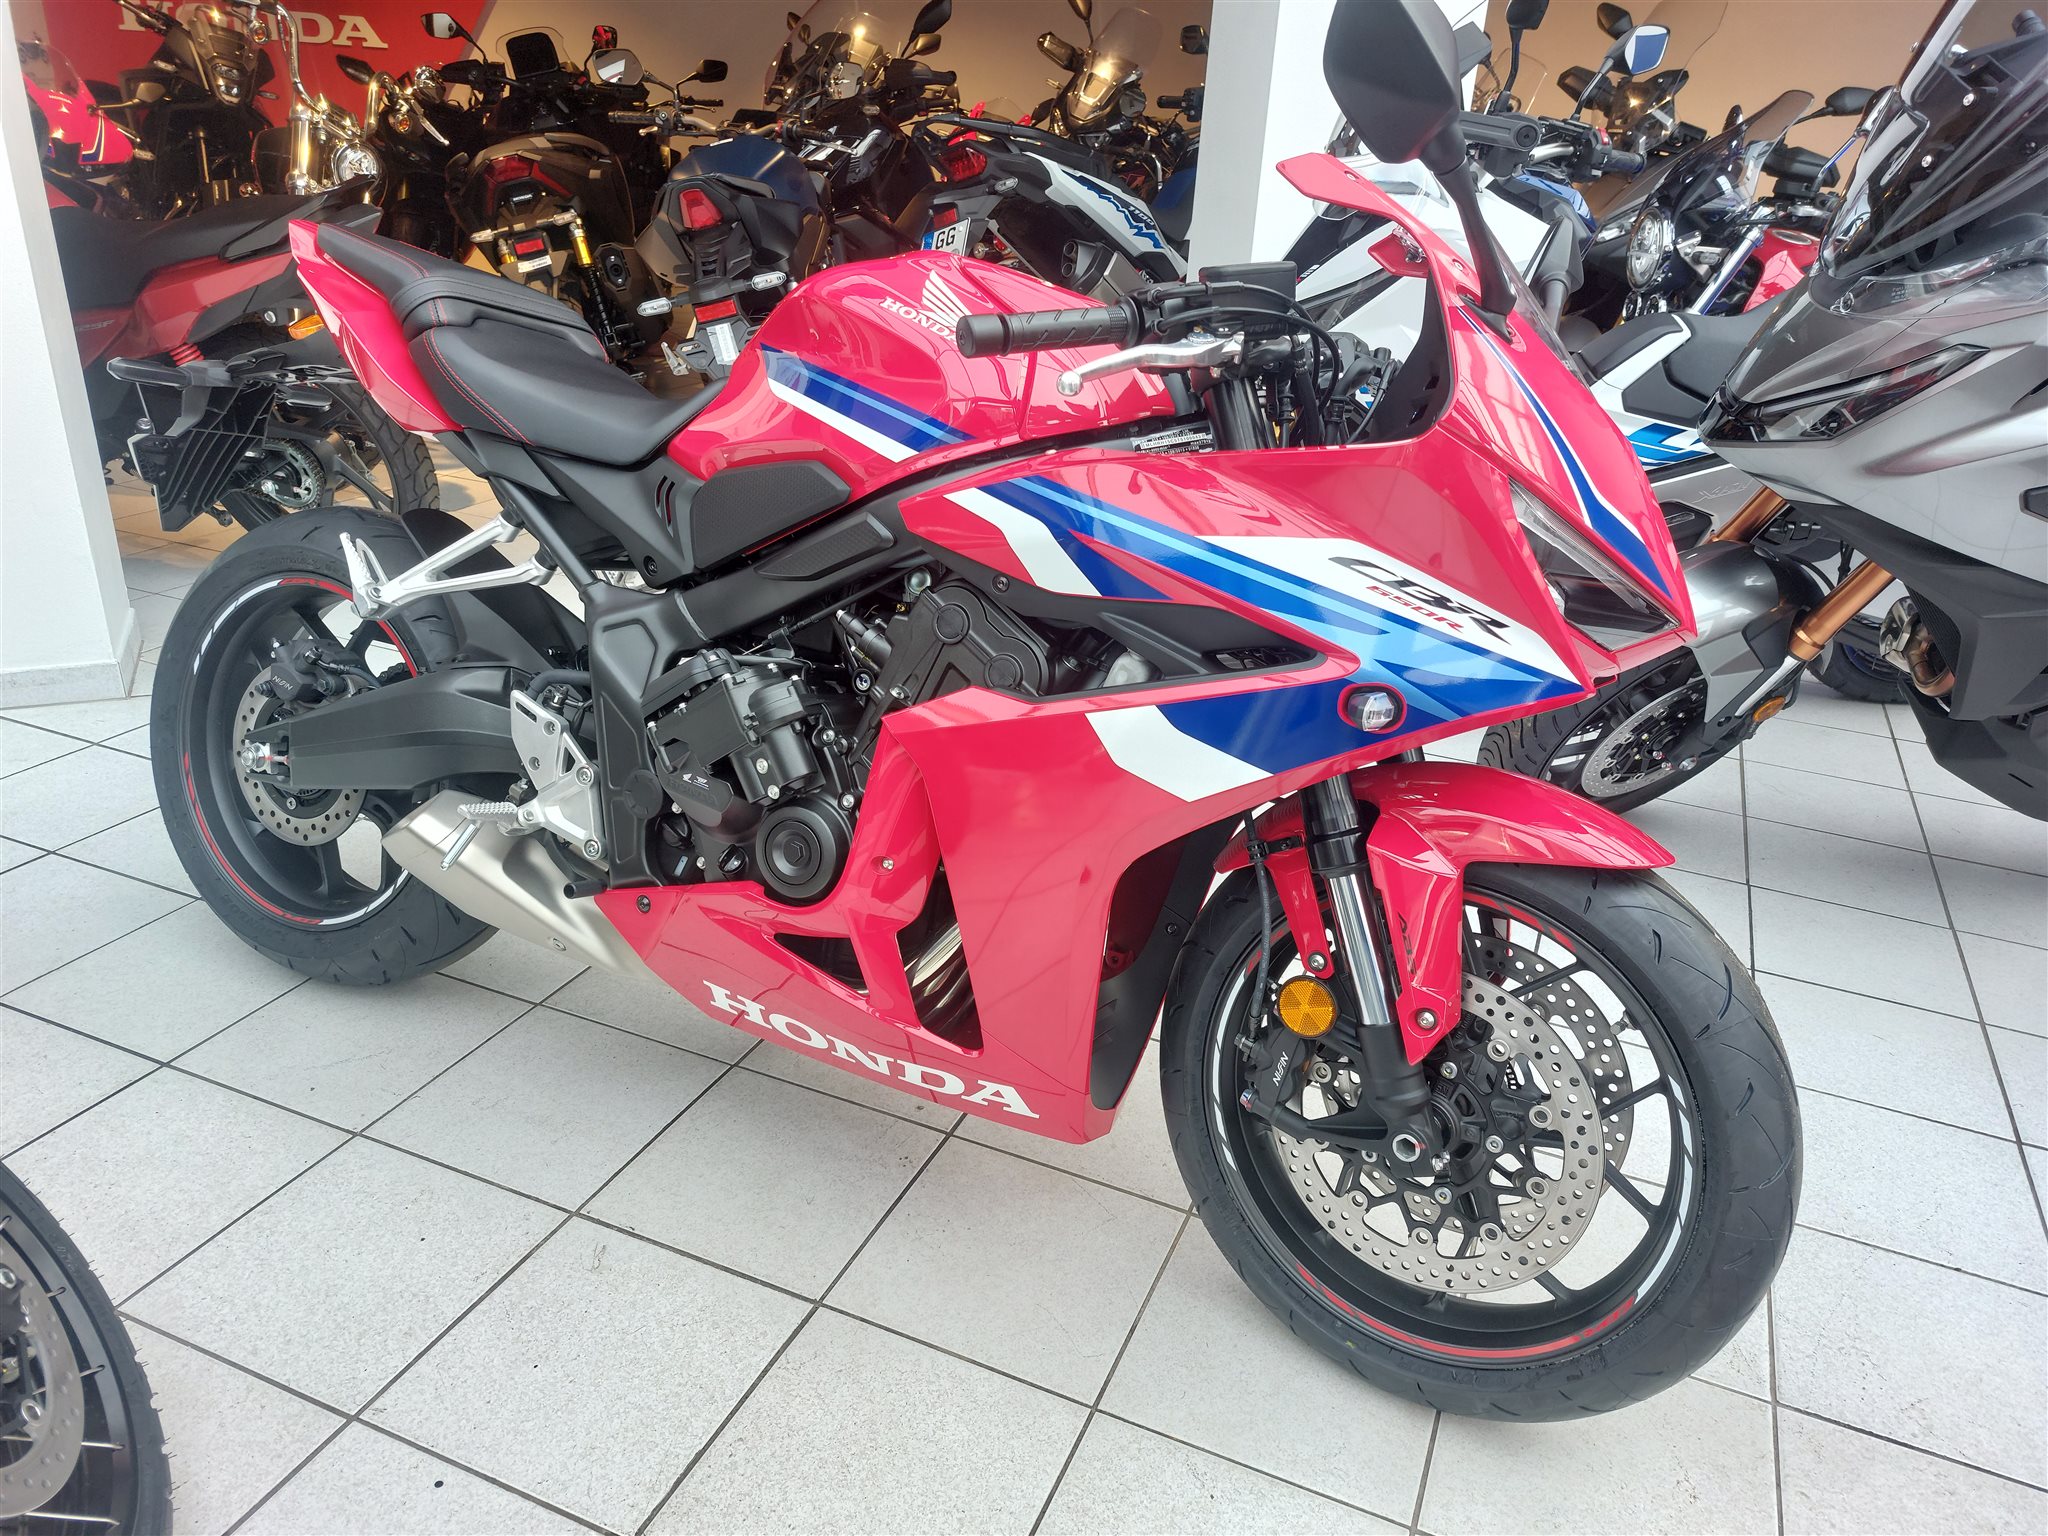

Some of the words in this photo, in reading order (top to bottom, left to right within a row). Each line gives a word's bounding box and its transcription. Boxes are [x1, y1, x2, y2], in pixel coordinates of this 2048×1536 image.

[1128, 205, 1156, 226] 1100
[935, 226, 956, 250] GG
[1327, 556, 1513, 646] CBR
[1365, 585, 1465, 635] 650R
[702, 979, 1040, 1119] HONDA
[1271, 1050, 1289, 1087] NISSIN
